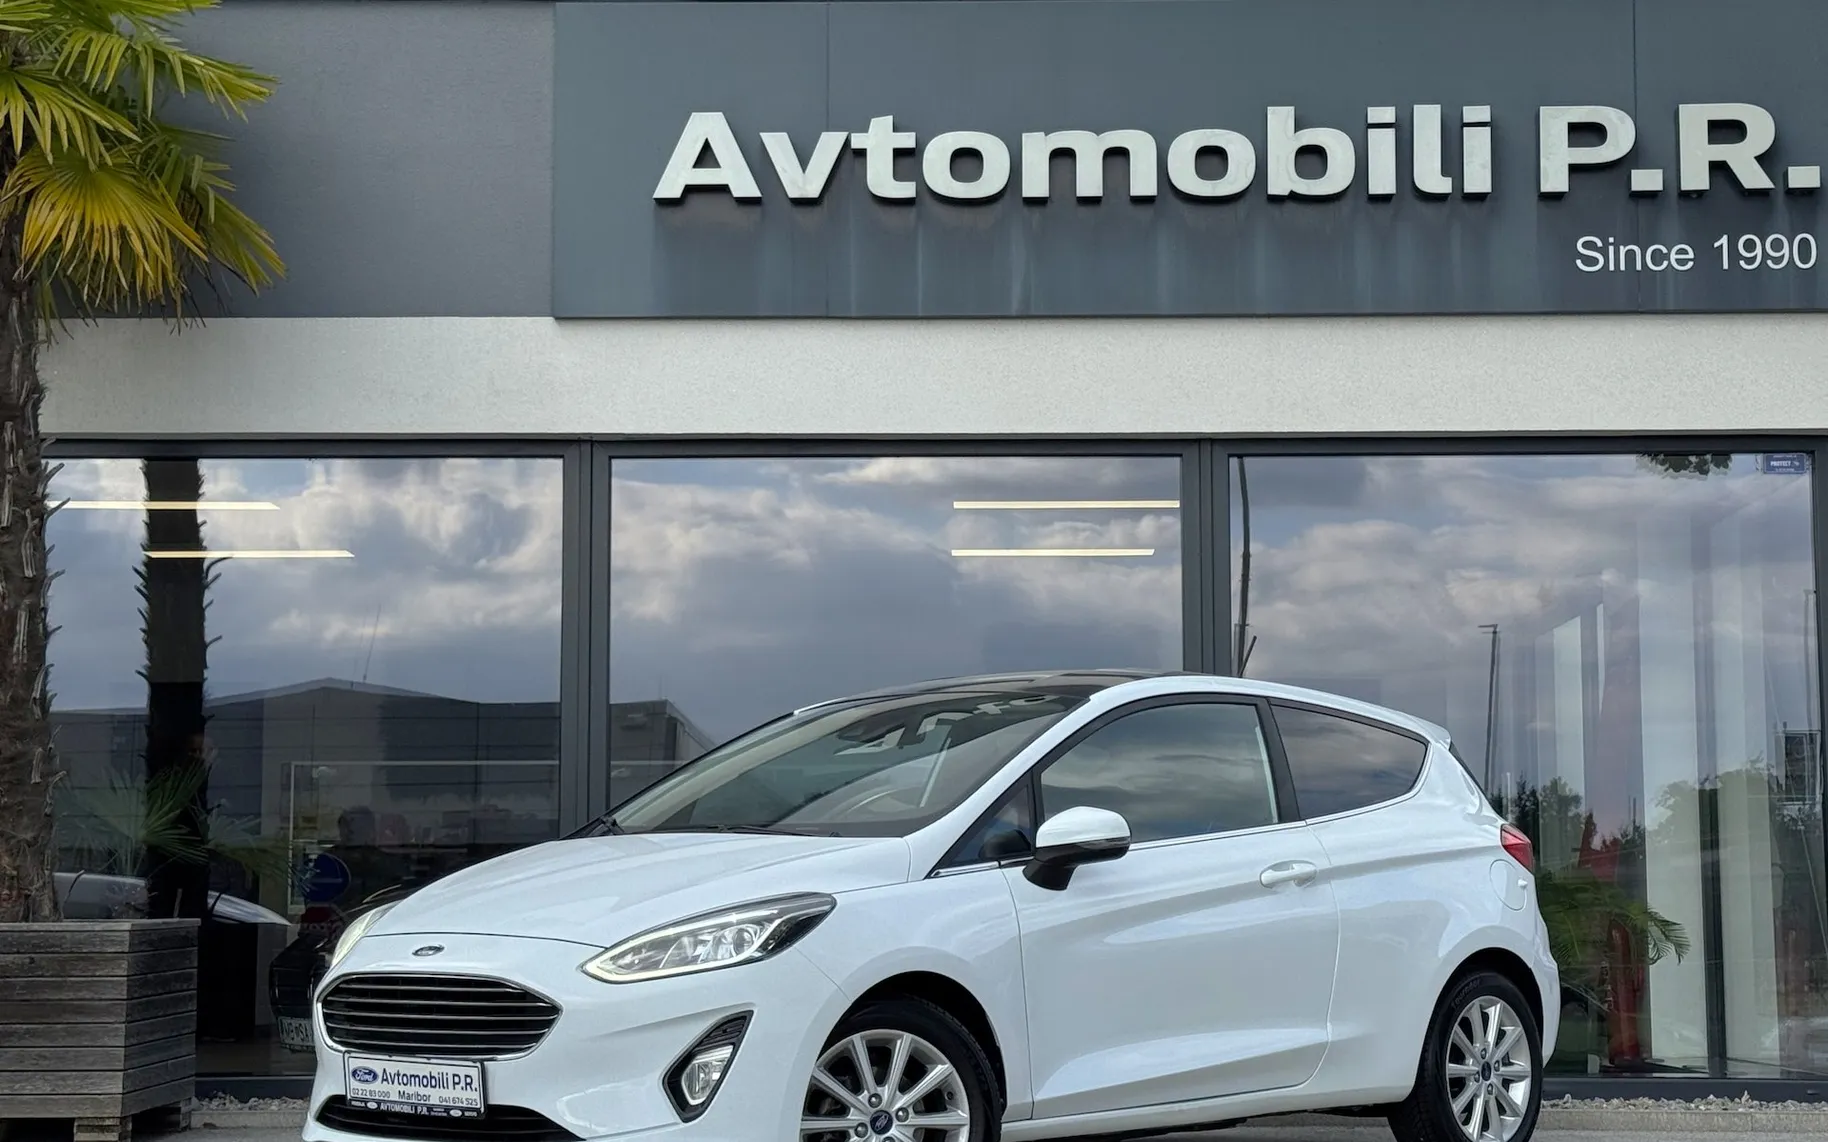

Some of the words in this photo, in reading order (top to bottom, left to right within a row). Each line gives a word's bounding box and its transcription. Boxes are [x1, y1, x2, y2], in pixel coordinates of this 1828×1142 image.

[652, 103, 1493, 202] Avtomobili
[1539, 103, 1821, 198] P.R.
[1575, 236, 1695, 272] Since
[1713, 233, 1818, 270] 1990
[381, 1067, 449, 1090] Avtomobili
[452, 1073, 478, 1092] P.R.
[398, 1090, 431, 1102] Maribor
[438, 1095, 451, 1104] 041
